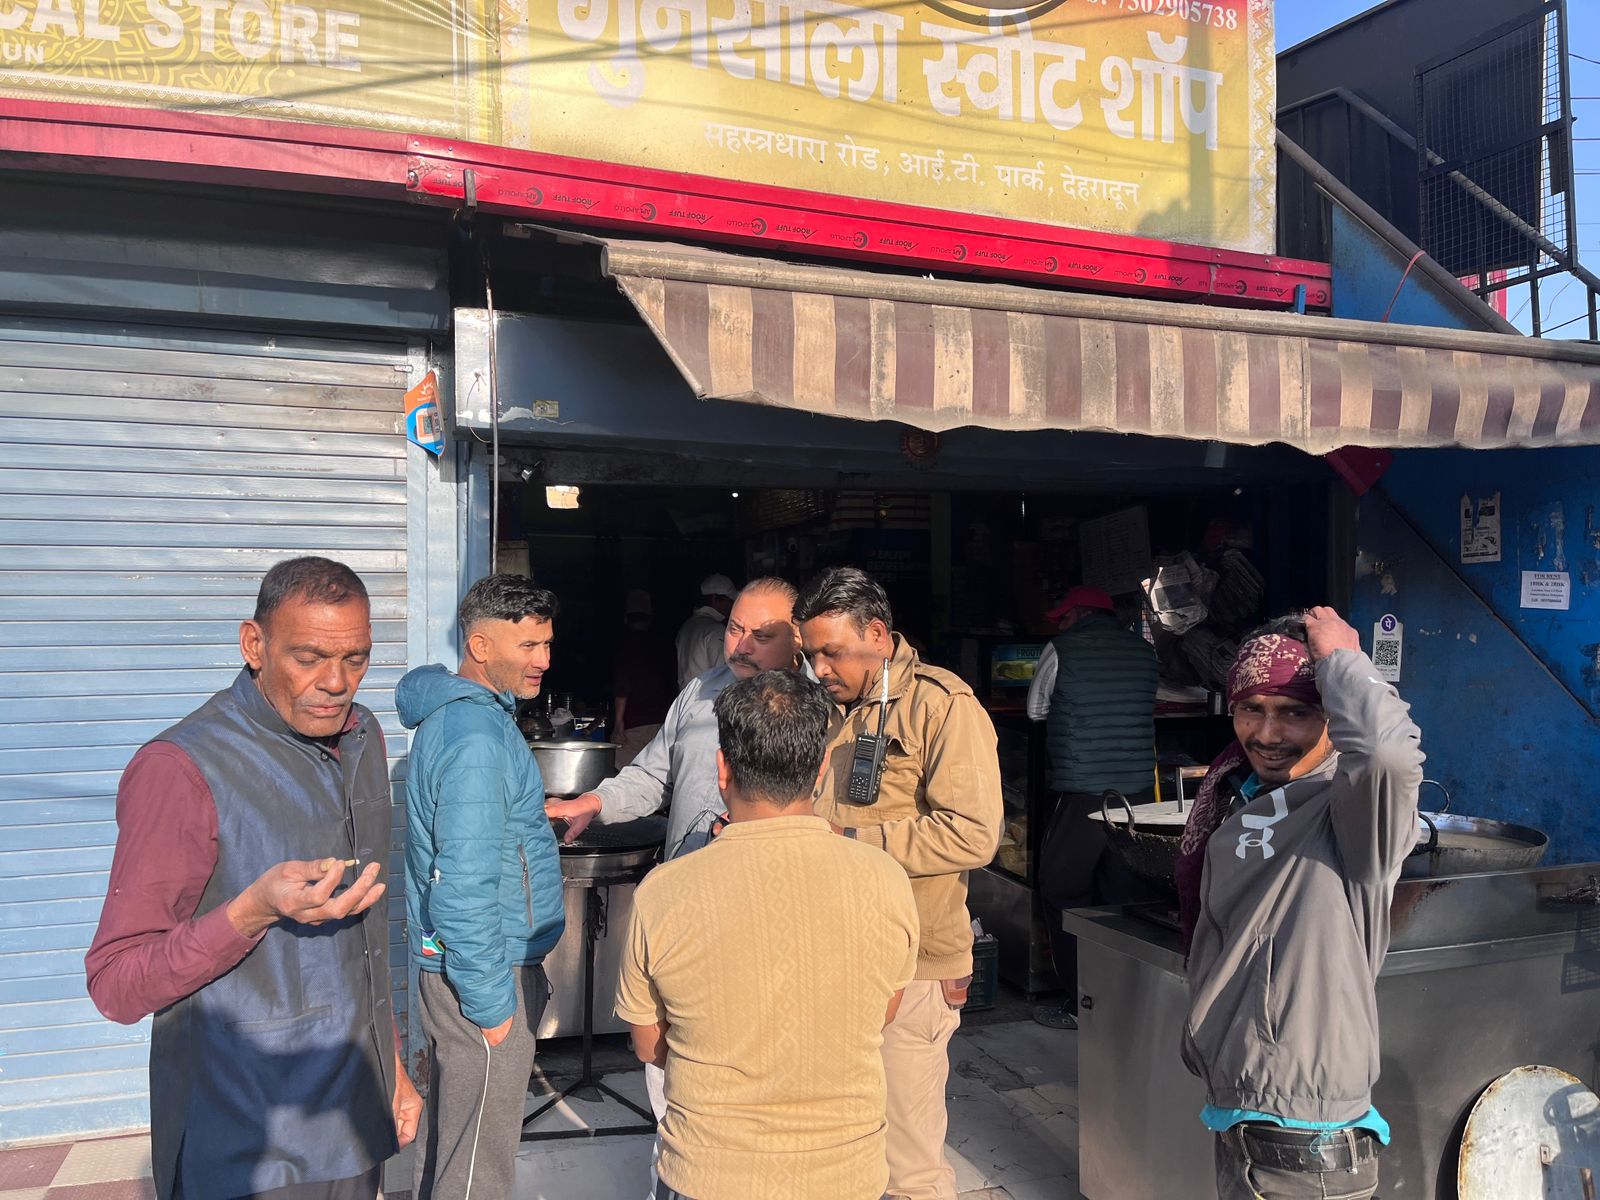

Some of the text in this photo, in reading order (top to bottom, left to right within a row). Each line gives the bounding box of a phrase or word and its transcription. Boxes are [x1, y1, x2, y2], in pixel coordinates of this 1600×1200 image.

[143, 0, 361, 73] STORE
[921, 8, 1086, 131] स्वीट
[1099, 31, 1223, 151] शॉप
[835, 135, 890, 177] रोड,
[994, 160, 1054, 197] पार्क,
[1061, 165, 1140, 210] देहरादून
